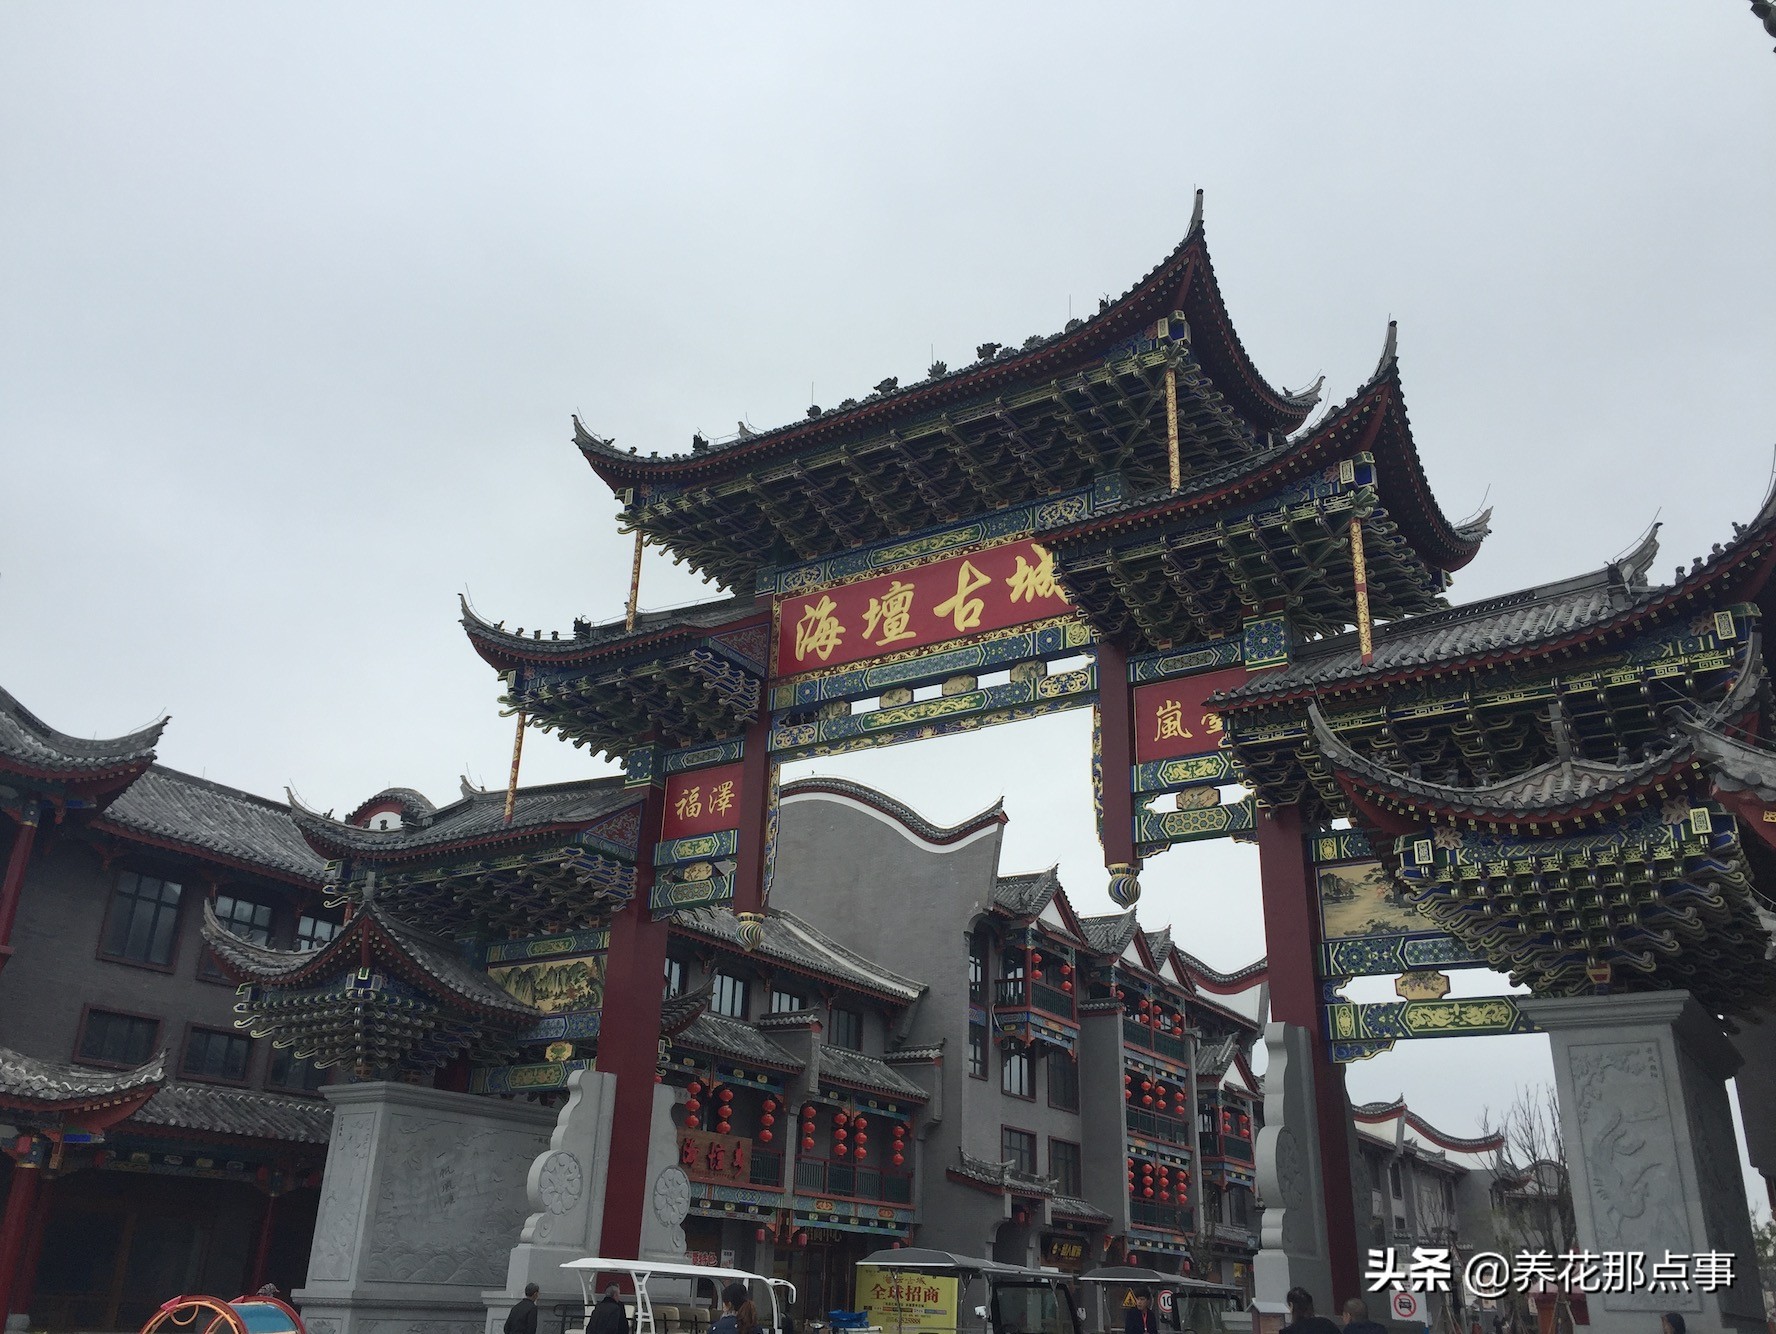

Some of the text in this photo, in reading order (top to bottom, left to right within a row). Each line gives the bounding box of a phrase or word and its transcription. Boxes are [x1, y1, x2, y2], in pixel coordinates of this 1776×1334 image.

[795, 543, 1072, 661] 海壇古城
[674, 780, 735, 820] 福澤
[870, 1283, 941, 1304] 全球招商
[1162, 1296, 1173, 1307] 10
